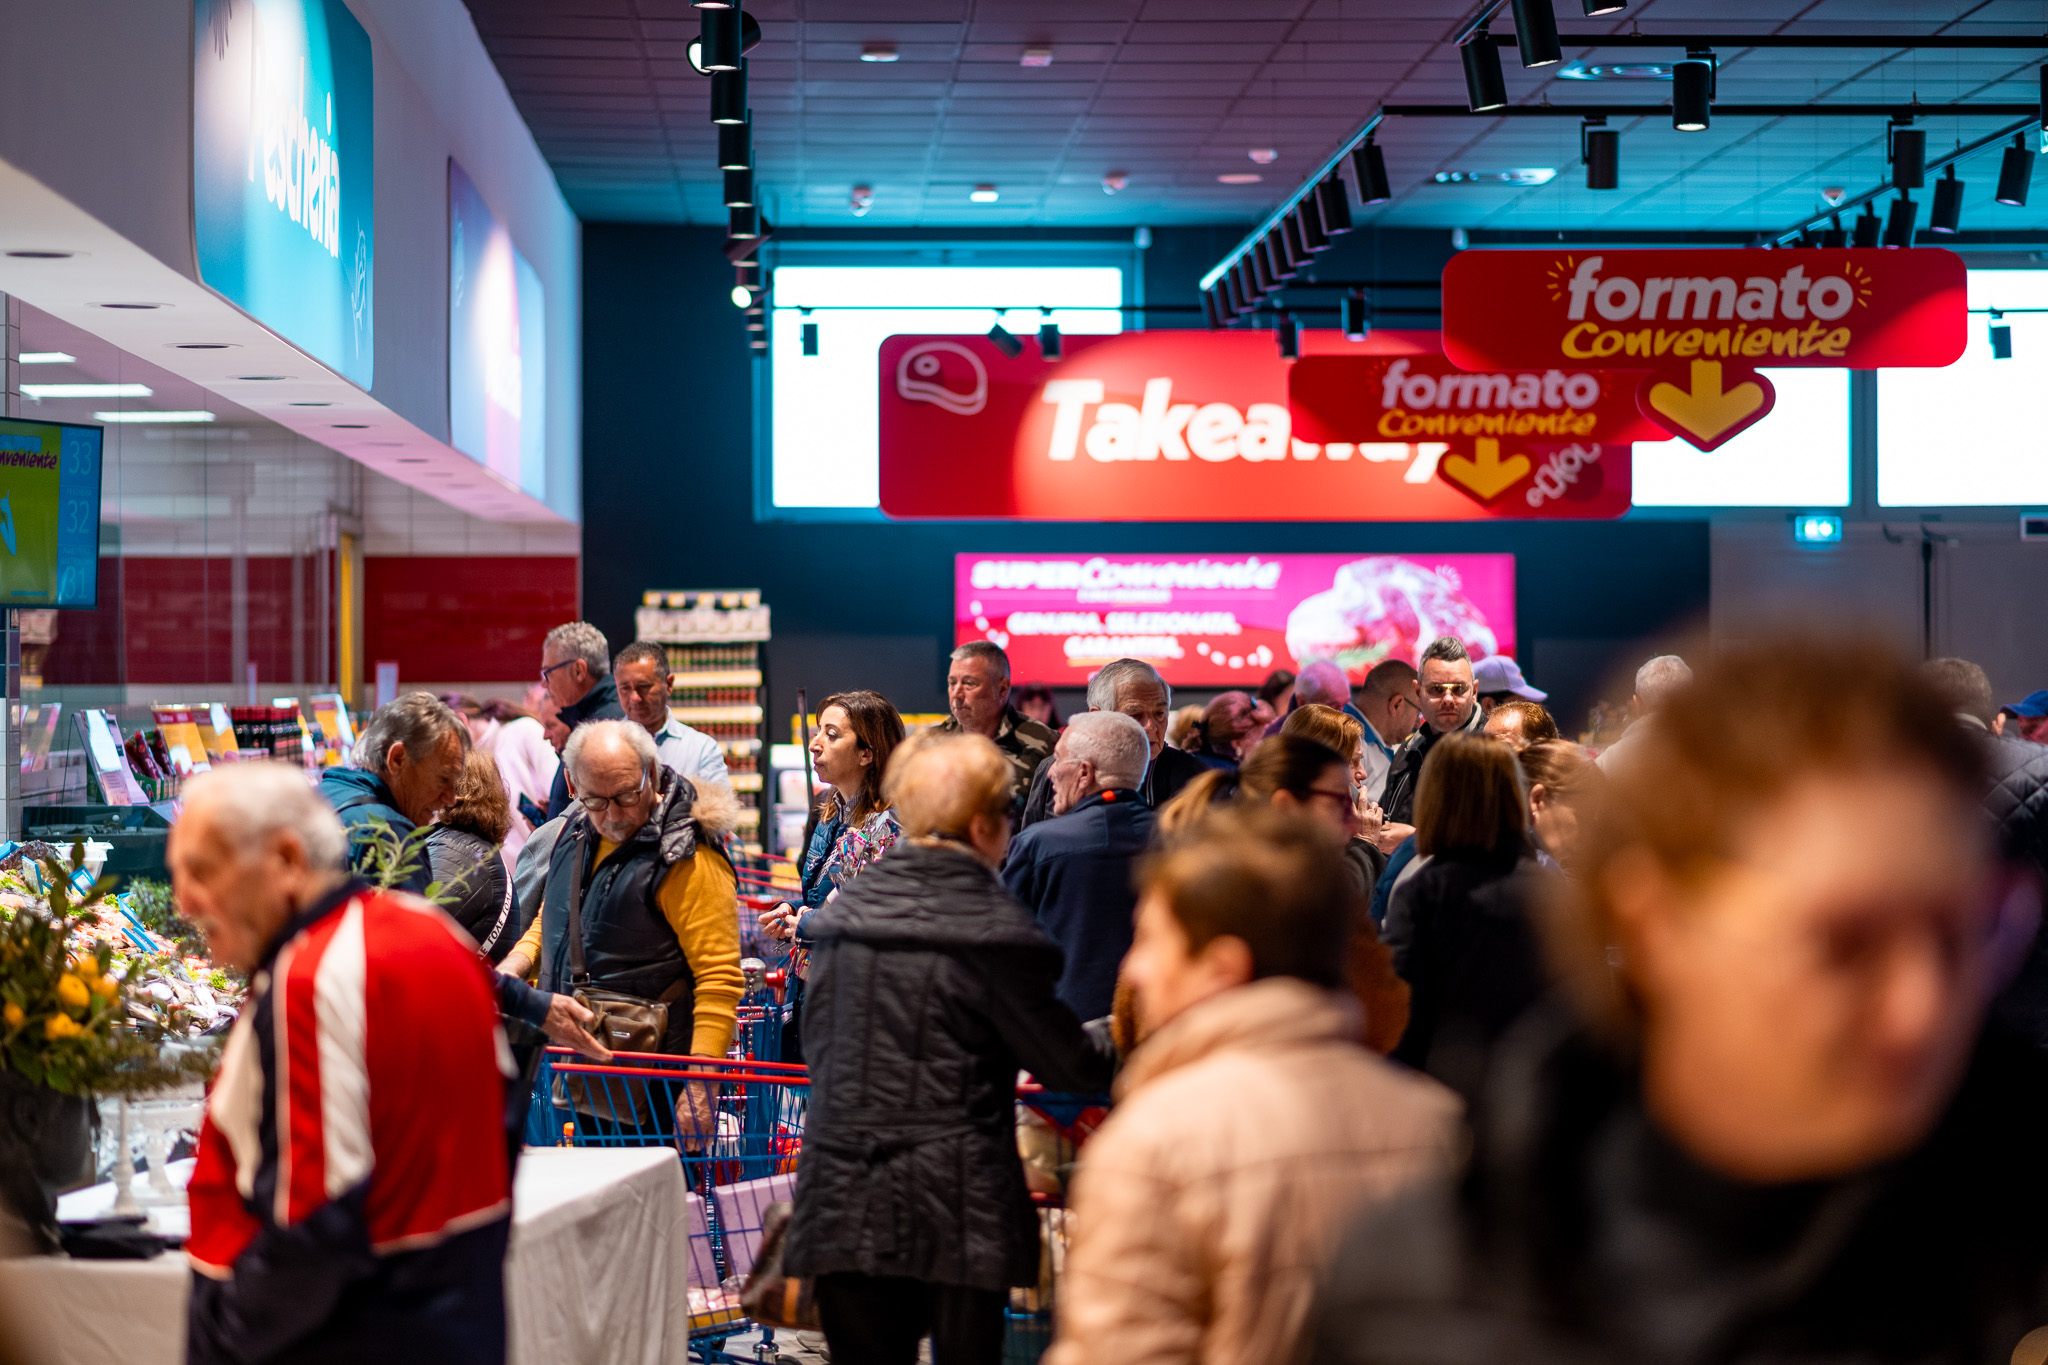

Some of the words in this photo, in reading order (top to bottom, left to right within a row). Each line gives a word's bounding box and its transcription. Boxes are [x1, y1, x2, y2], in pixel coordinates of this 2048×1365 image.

[1567, 256, 1854, 321] formato
[1561, 320, 1851, 359] Conveniente
[1381, 358, 1600, 409] formato
[1041, 377, 1451, 484] Takeay
[1377, 406, 1598, 438] Conveniente
[0, 450, 58, 469] nveniente
[69, 440, 92, 475] 33
[66, 500, 90, 534] 32
[64, 565, 88, 599] 31
